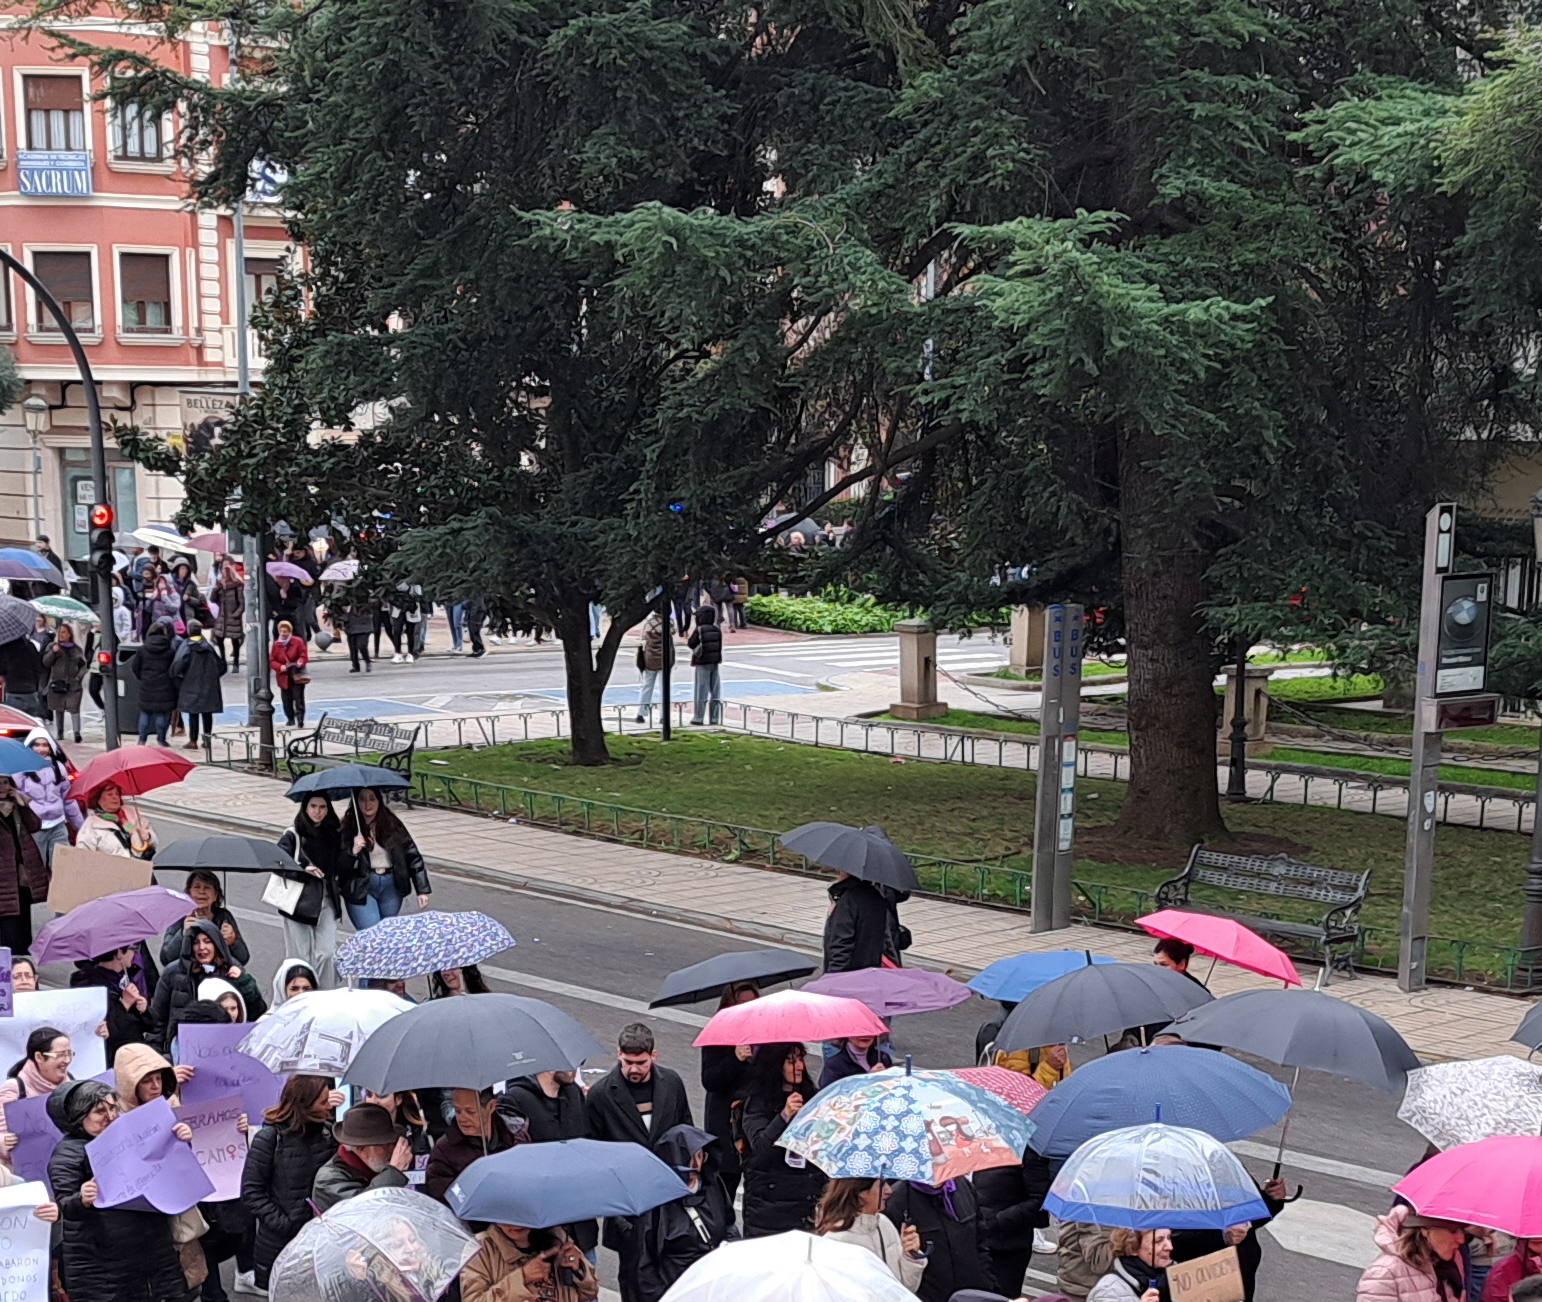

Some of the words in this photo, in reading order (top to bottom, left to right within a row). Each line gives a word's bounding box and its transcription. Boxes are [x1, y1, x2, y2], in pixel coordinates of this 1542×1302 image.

[19, 169, 88, 194] SACRUM
[1053, 630, 1062, 678] BUS
[1069, 629, 1079, 676] BUS
[183, 1108, 240, 1130] BRAMOS
